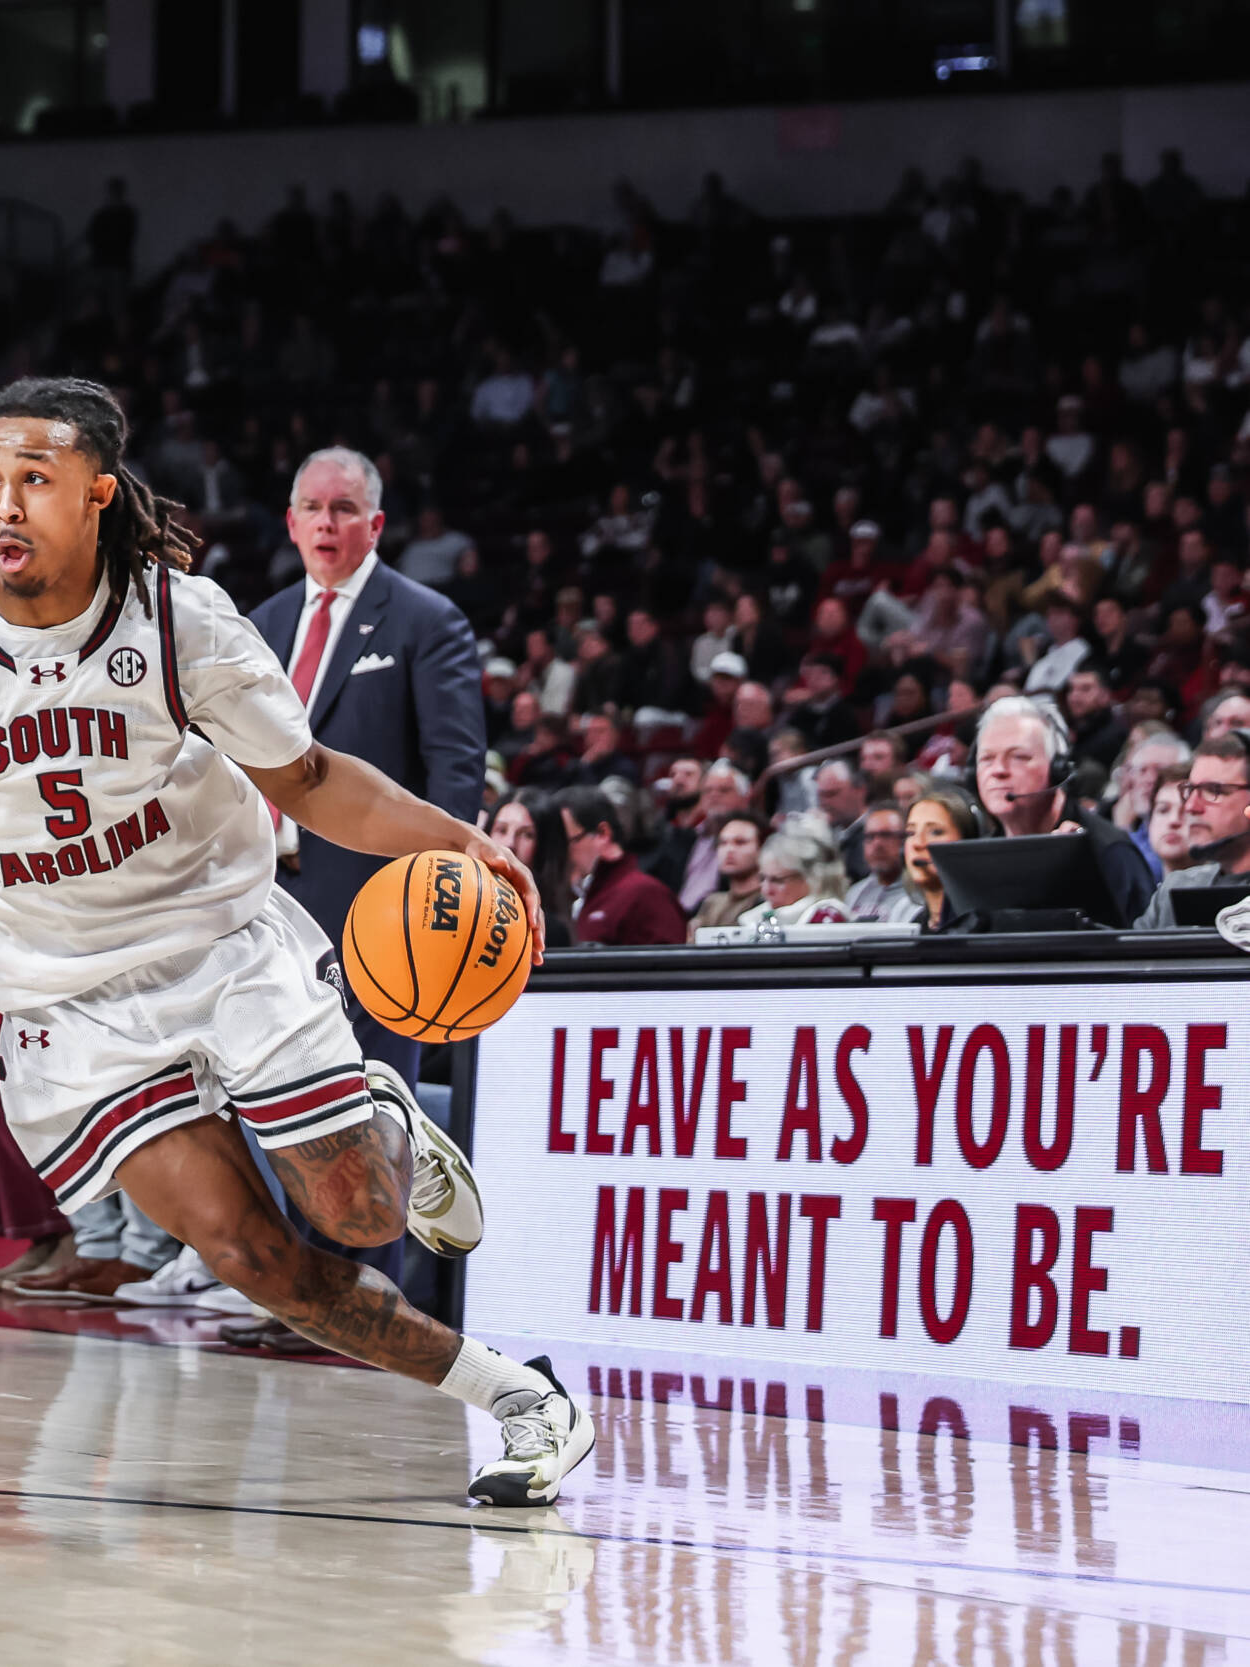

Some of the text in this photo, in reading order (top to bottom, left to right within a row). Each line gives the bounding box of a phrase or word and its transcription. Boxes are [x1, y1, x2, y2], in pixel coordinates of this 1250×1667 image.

[109, 649, 144, 685] SEC
[36, 768, 92, 840] 5
[430, 857, 463, 931] NCAA
[548, 1022, 1228, 1176] LEAVE AS YOU'RE
[588, 1185, 1140, 1359] MEANT TO BE.
